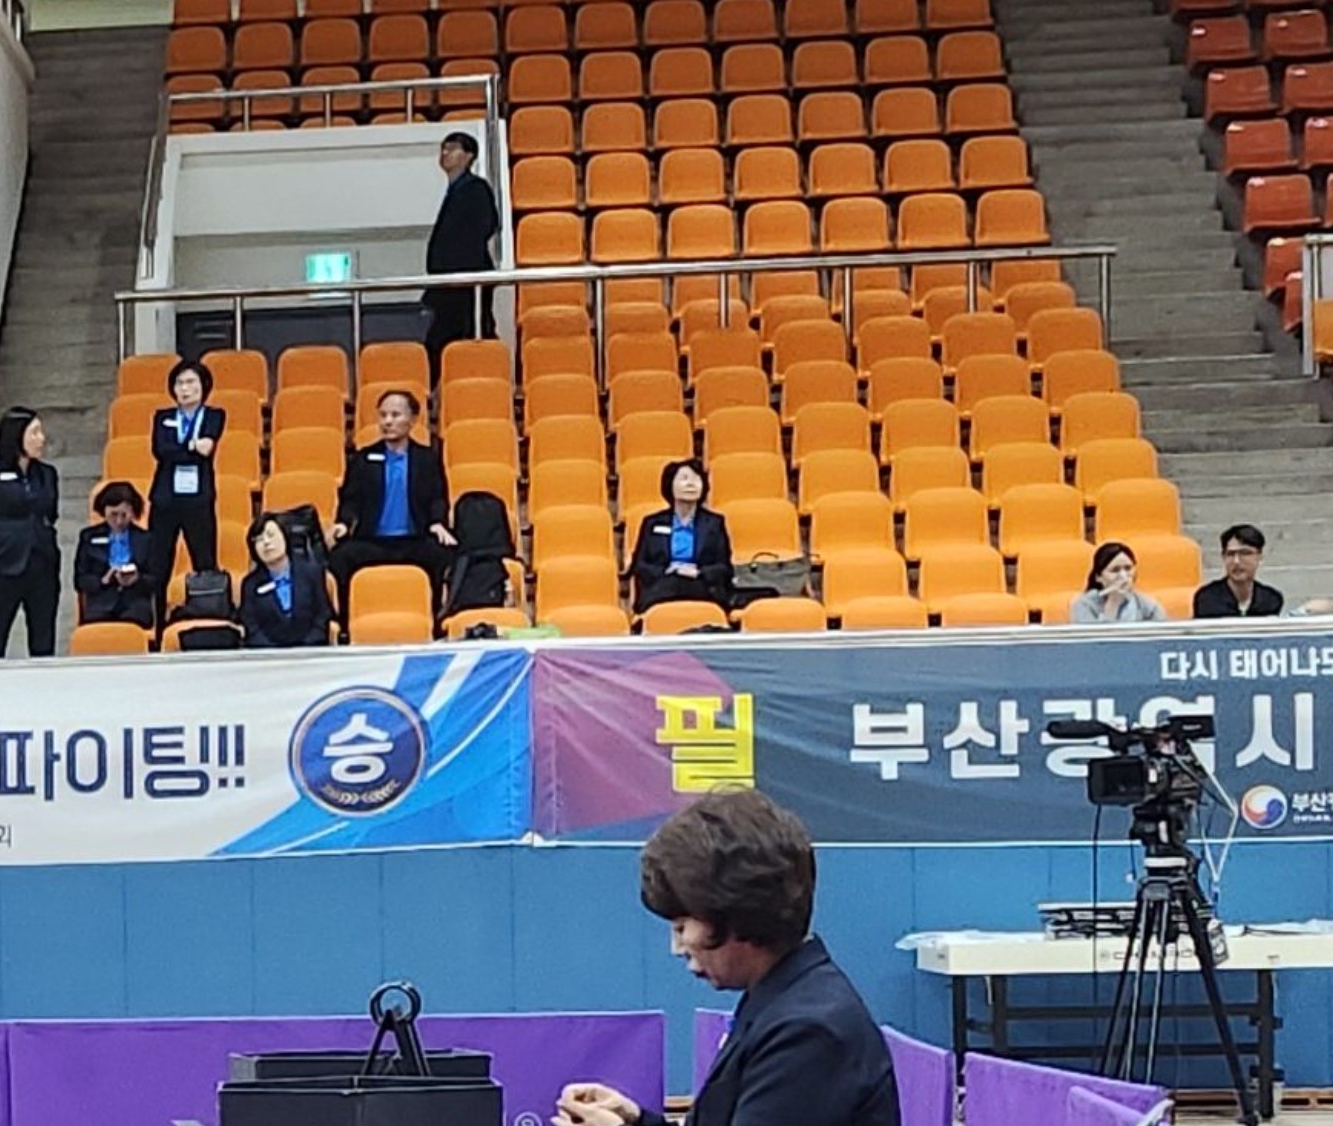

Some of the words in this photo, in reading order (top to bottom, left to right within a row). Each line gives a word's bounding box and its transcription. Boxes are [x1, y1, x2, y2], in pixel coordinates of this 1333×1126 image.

[1160, 650, 1219, 680] 다시
[323, 713, 393, 784] 승
[655, 694, 756, 791] 필
